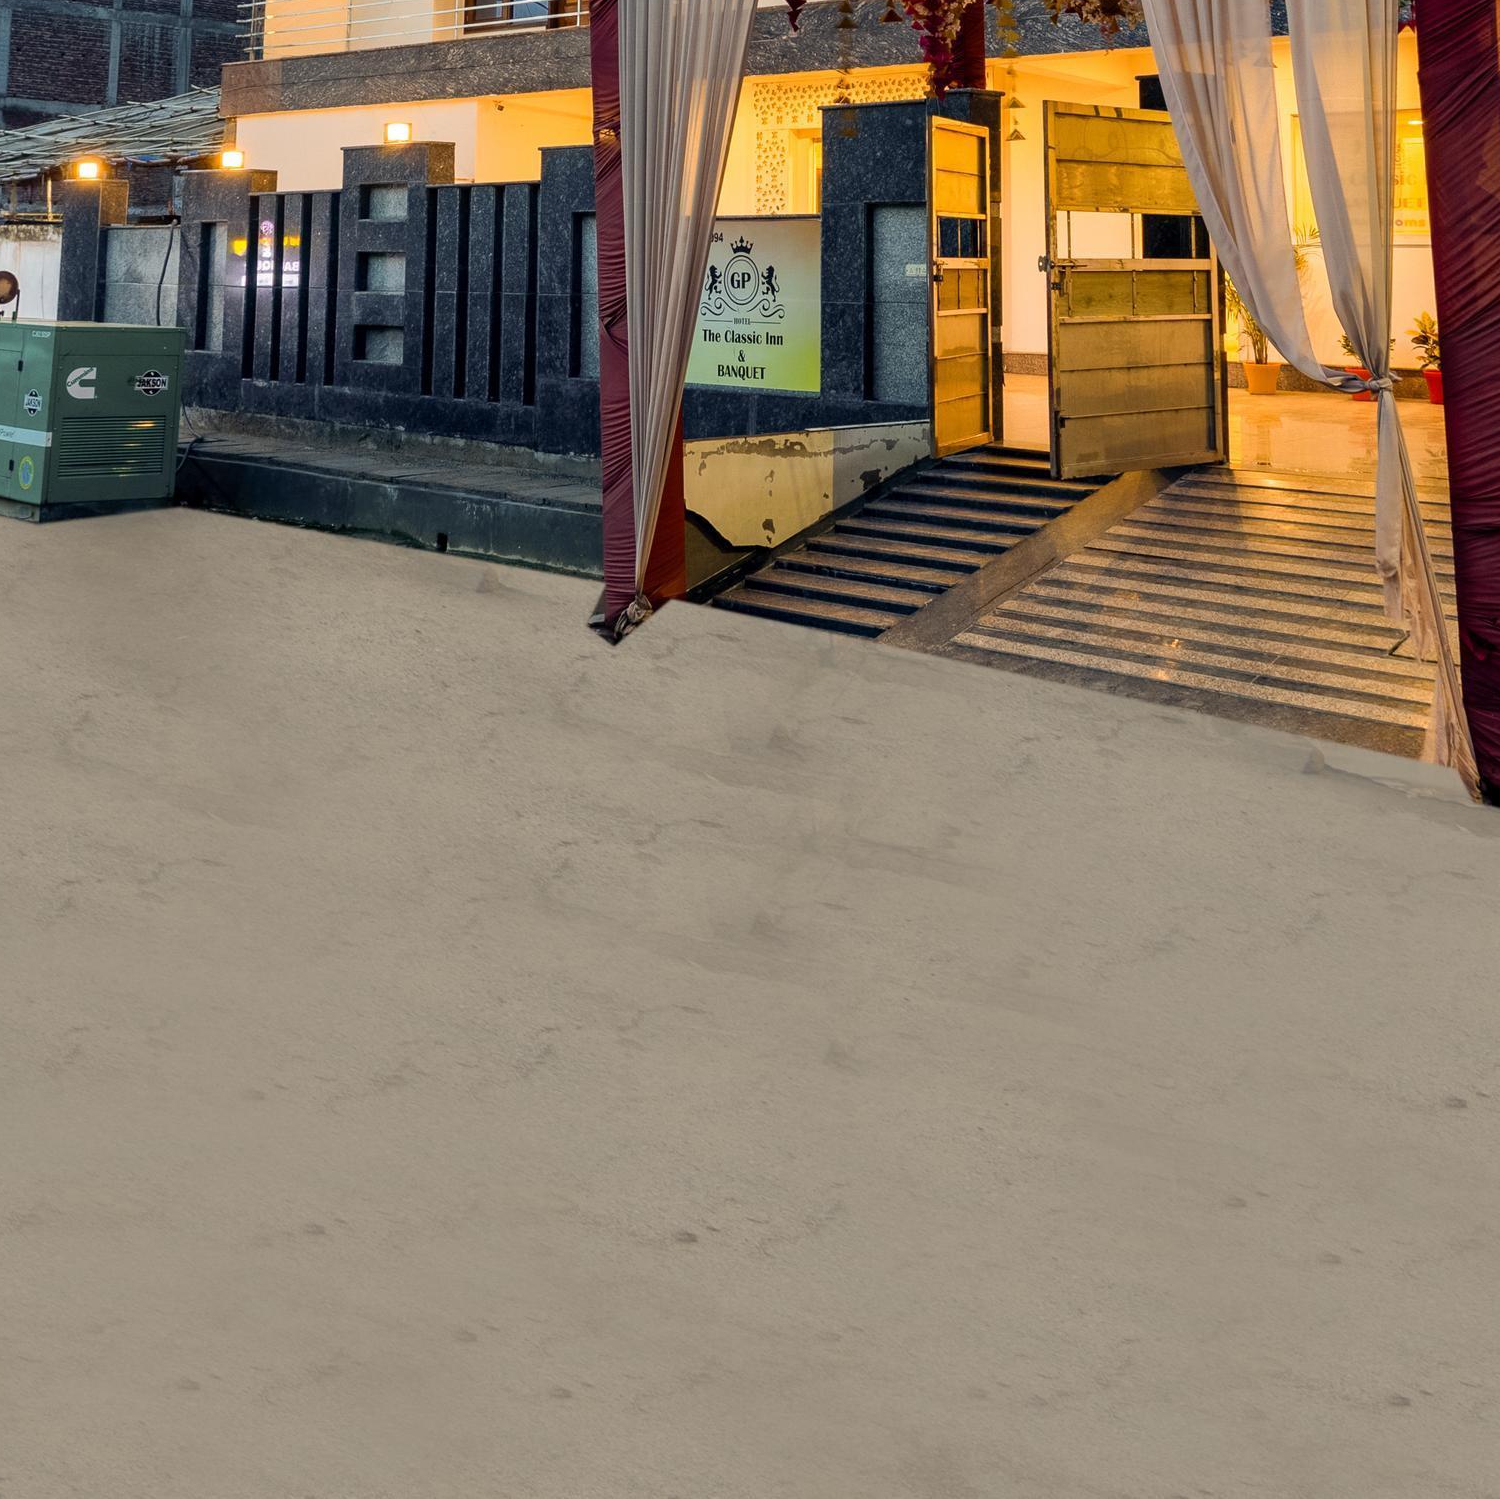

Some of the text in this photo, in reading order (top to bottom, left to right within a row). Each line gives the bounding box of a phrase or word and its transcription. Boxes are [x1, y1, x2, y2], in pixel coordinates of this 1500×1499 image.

[730, 271, 752, 289] GP
[733, 317, 751, 326] HOTEL
[702, 329, 784, 346] The Classic Inn
[737, 350, 746, 362] &
[717, 364, 767, 381] BANQUET
